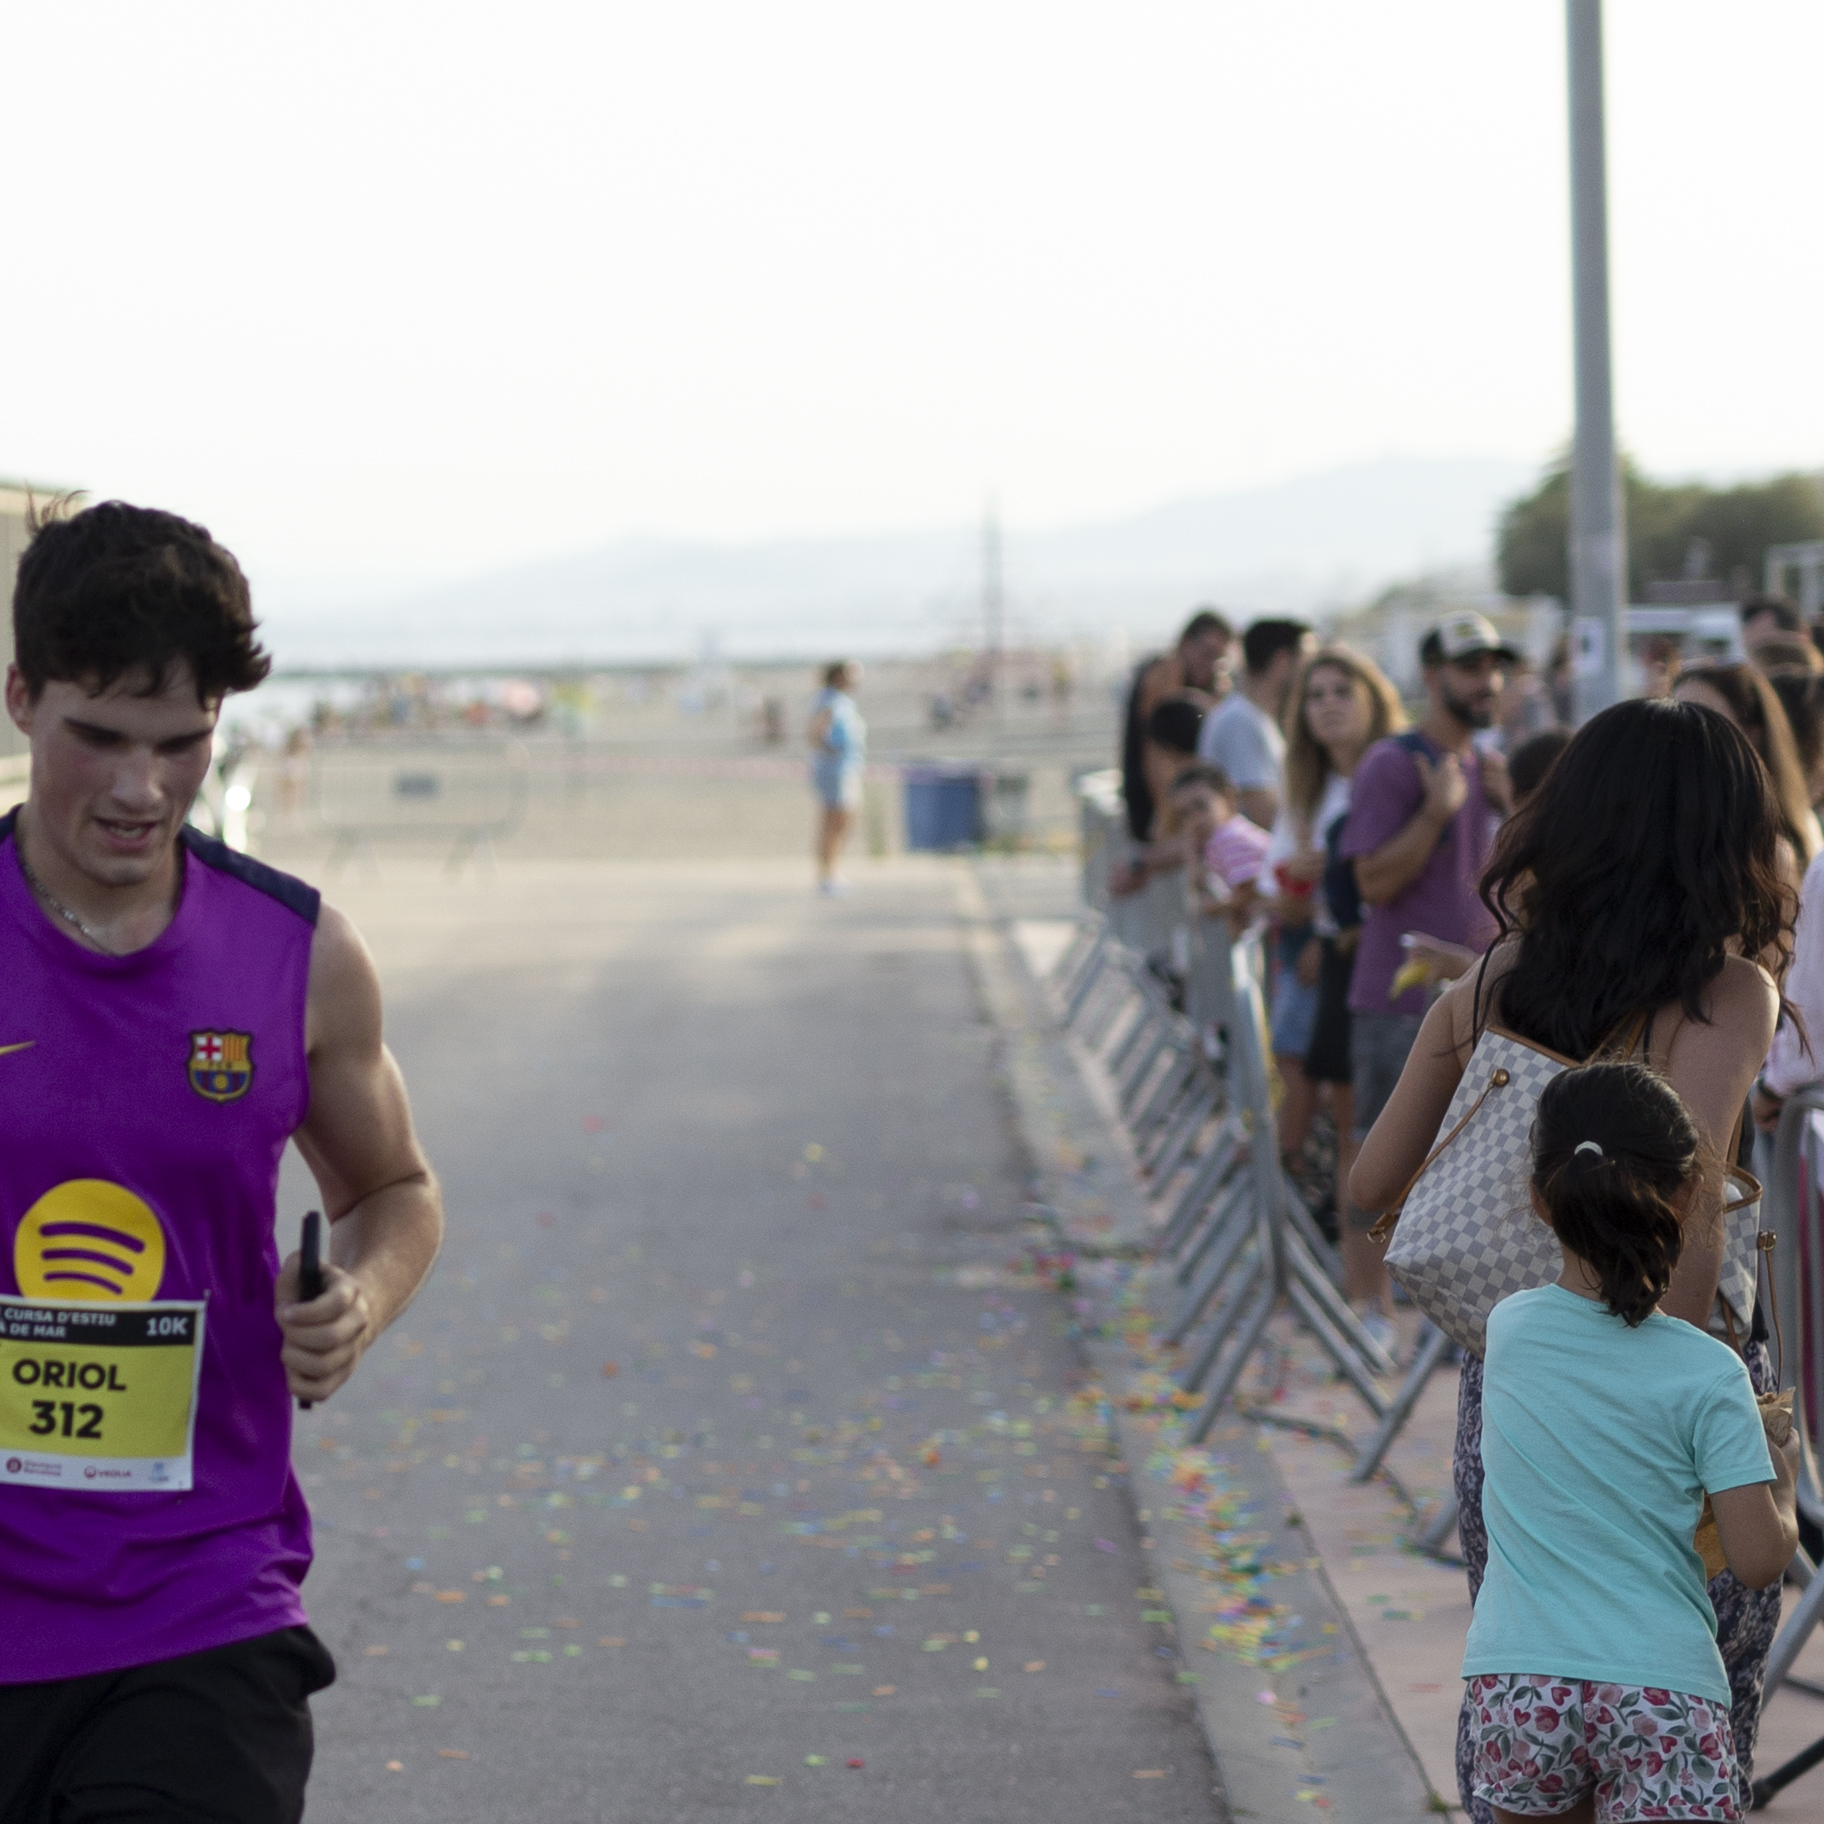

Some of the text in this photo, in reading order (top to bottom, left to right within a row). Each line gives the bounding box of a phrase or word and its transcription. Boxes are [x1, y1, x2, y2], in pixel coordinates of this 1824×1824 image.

[4, 1307, 53, 1323] CURSA
[57, 1311, 118, 1326] D'ESTIU
[146, 1316, 188, 1336] 10K
[10, 1323, 31, 1336] DE
[33, 1324, 68, 1338] MAR
[12, 1358, 127, 1391] ORIOL
[28, 1399, 104, 1439] 312
